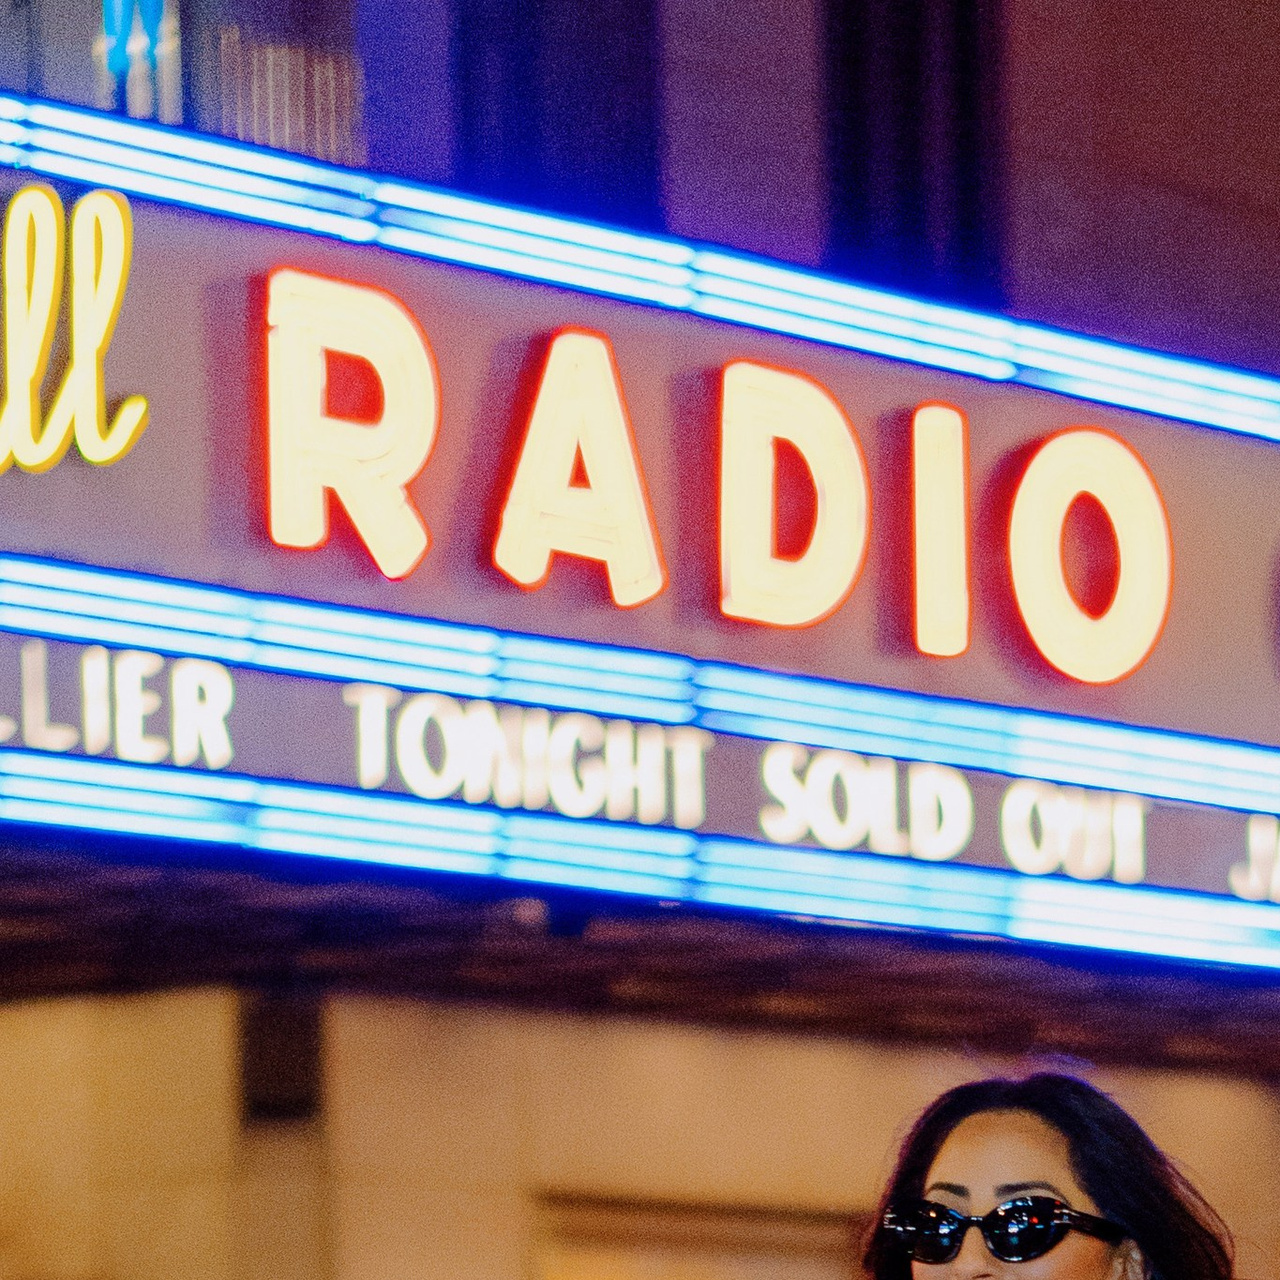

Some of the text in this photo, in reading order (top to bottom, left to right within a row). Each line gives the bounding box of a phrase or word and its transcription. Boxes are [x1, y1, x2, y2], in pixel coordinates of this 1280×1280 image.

[0, 184, 148, 473] ll
[265, 267, 1175, 686] RADIO
[344, 681, 714, 828] TONIGHT
[760, 740, 974, 862] SOLD
[1000, 776, 1148, 884] OUT
